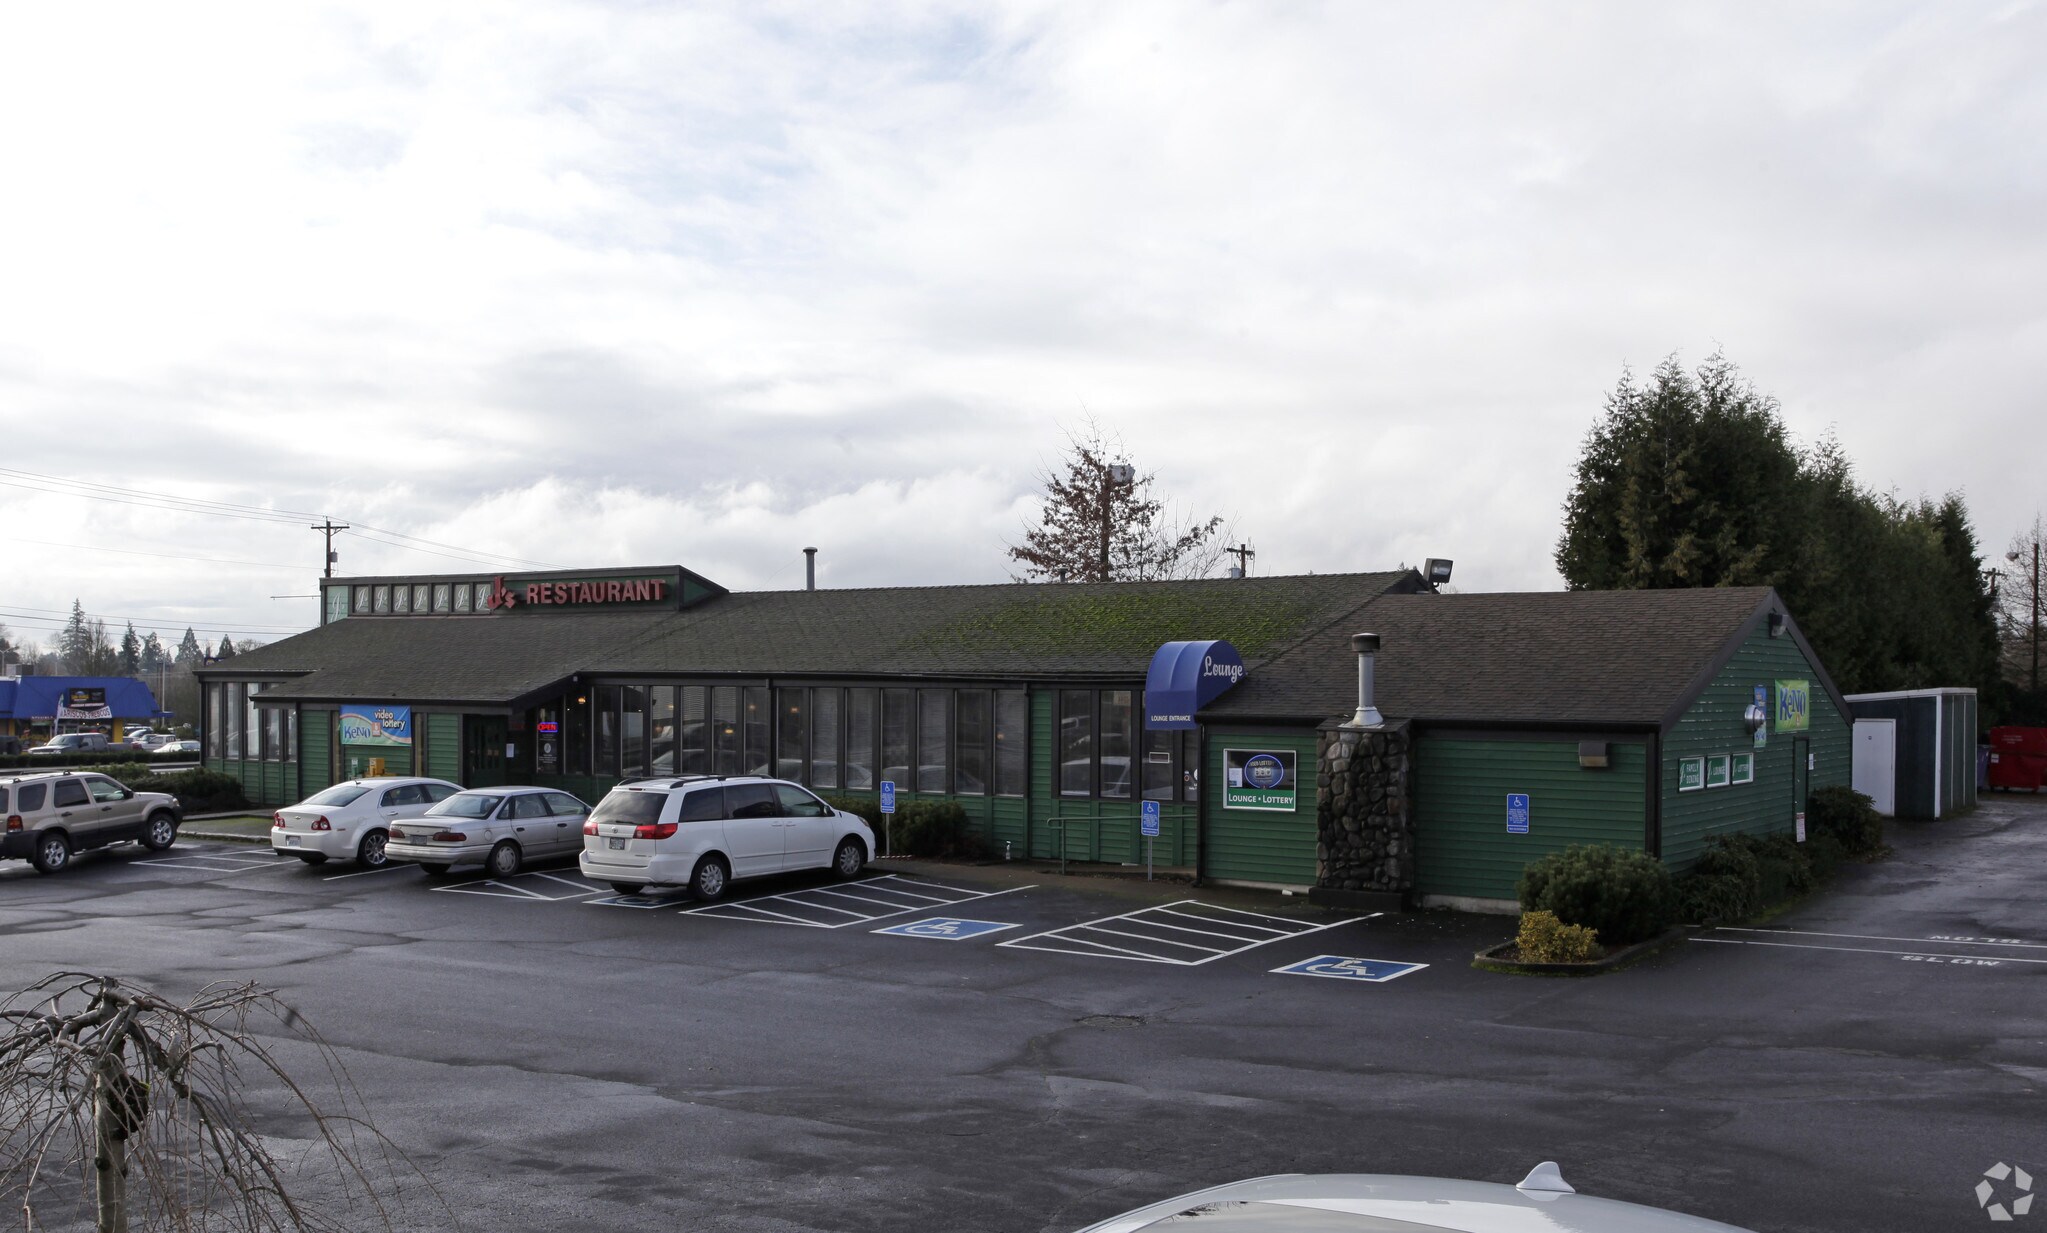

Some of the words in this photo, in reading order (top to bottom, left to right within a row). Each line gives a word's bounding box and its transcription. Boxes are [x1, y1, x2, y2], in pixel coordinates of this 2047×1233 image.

[526, 578, 666, 605] RESTAURANT
[1203, 655, 1243, 683] Lounge
[374, 708, 394, 719] video
[382, 719, 406, 731] lottery
[537, 723, 557, 731] OPEN
[1228, 793, 1257, 803] LOUNGE
[1262, 794, 1294, 804] LOTTERY
